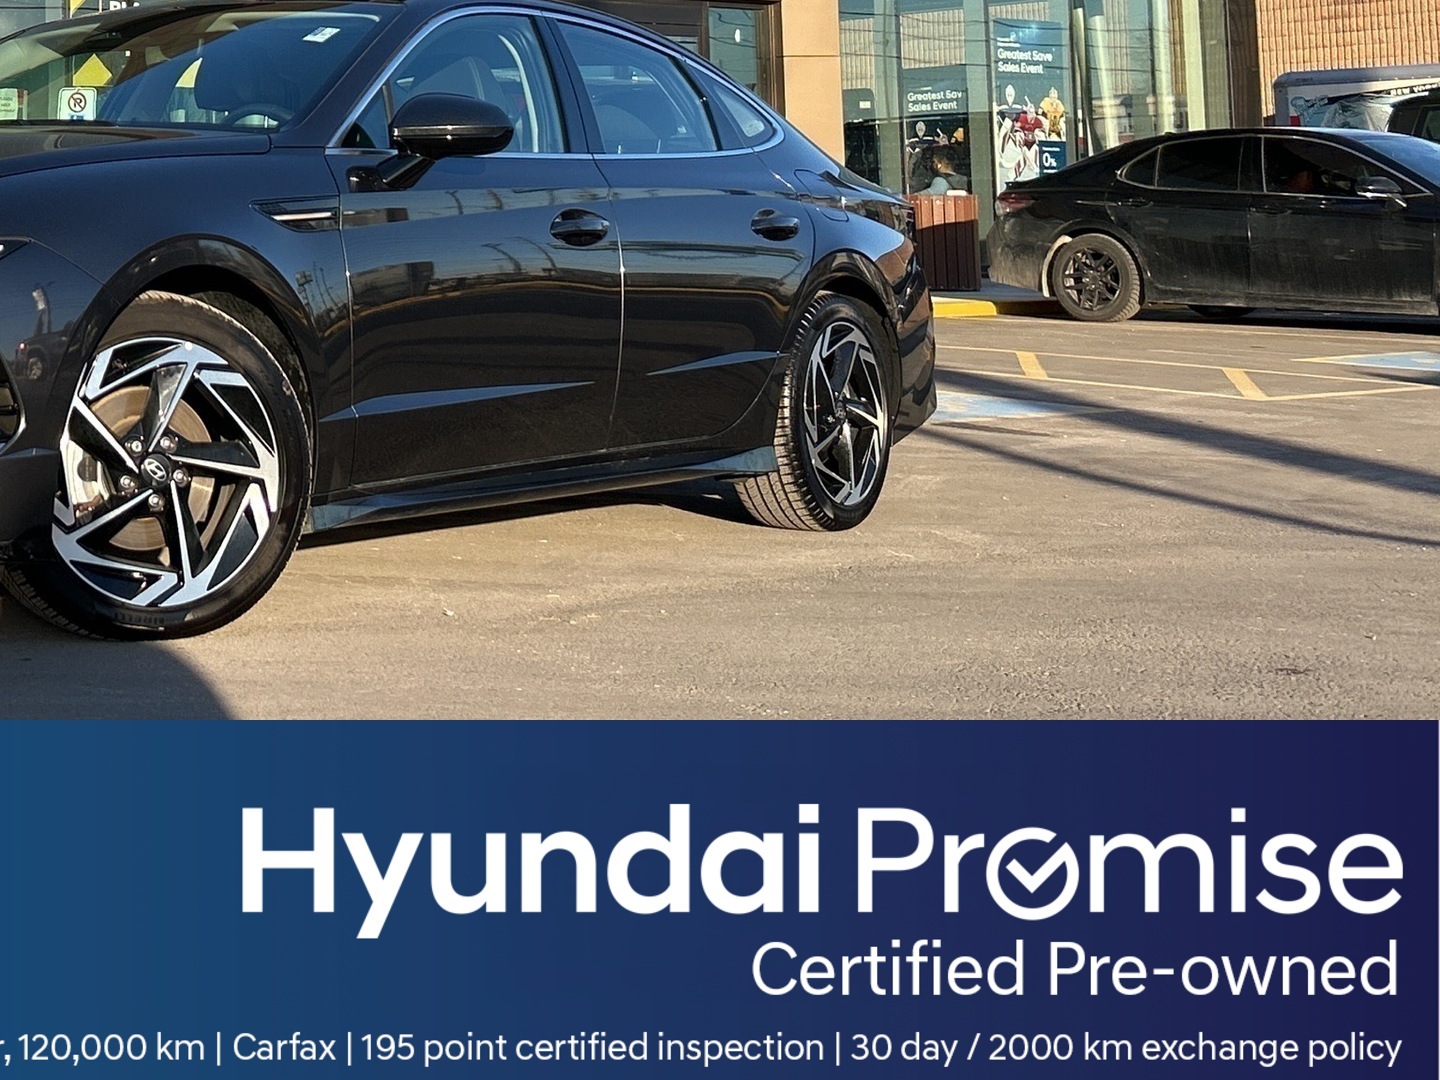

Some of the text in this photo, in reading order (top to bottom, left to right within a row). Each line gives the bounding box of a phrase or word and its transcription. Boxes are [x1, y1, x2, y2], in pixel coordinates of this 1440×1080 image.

[997, 48, 1053, 62] Greatest Save
[997, 62, 1043, 74] Sales Event
[907, 90, 944, 102] Greatest
[907, 100, 958, 112] Sales Event
